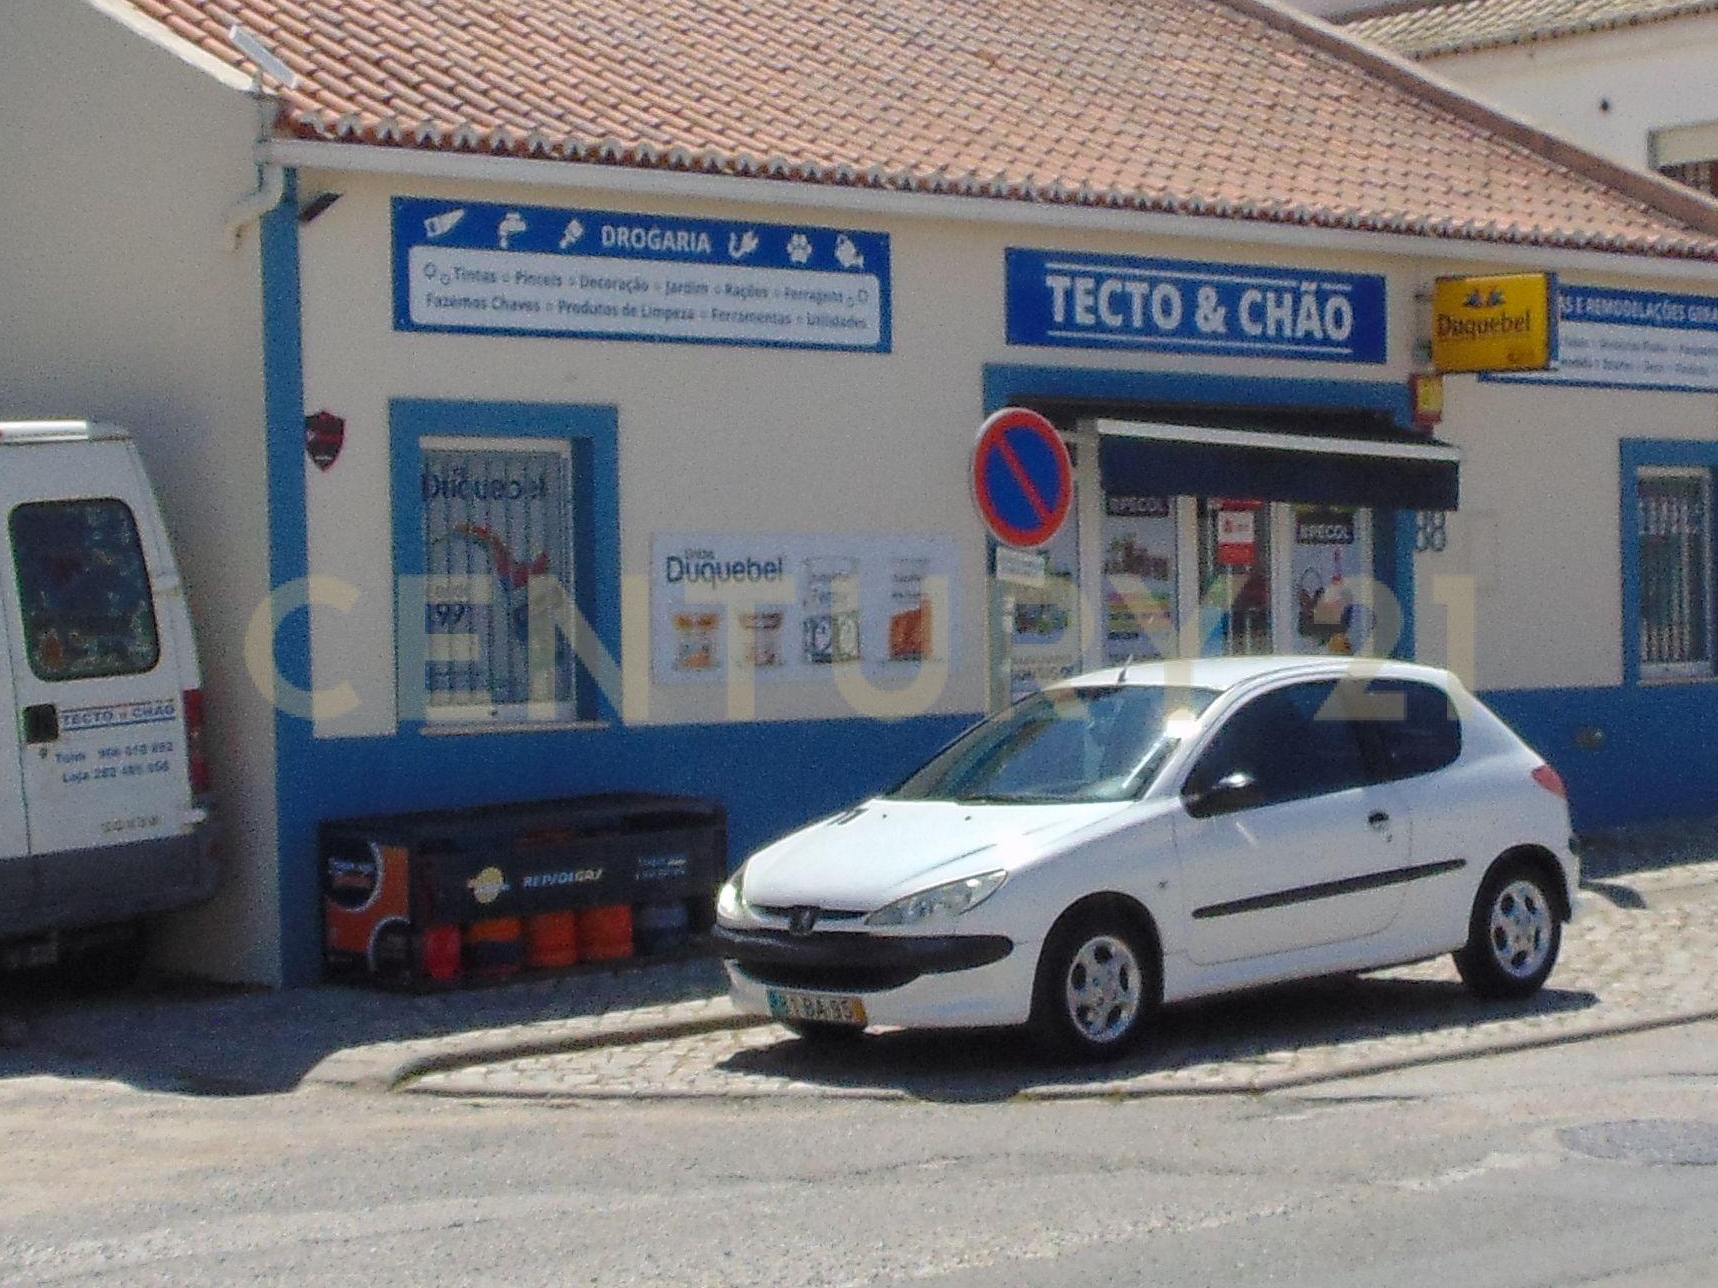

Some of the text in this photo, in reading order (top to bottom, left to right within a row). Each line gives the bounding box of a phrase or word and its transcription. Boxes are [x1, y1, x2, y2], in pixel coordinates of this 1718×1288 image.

[601, 225, 711, 254] DROGARIA
[453, 266, 496, 285] Tintas
[1045, 275, 1353, 341] TECTO & CHÃO
[1437, 310, 1532, 340] Duquebel
[665, 555, 783, 589] Duquebel
[62, 709, 113, 724] TECTO
